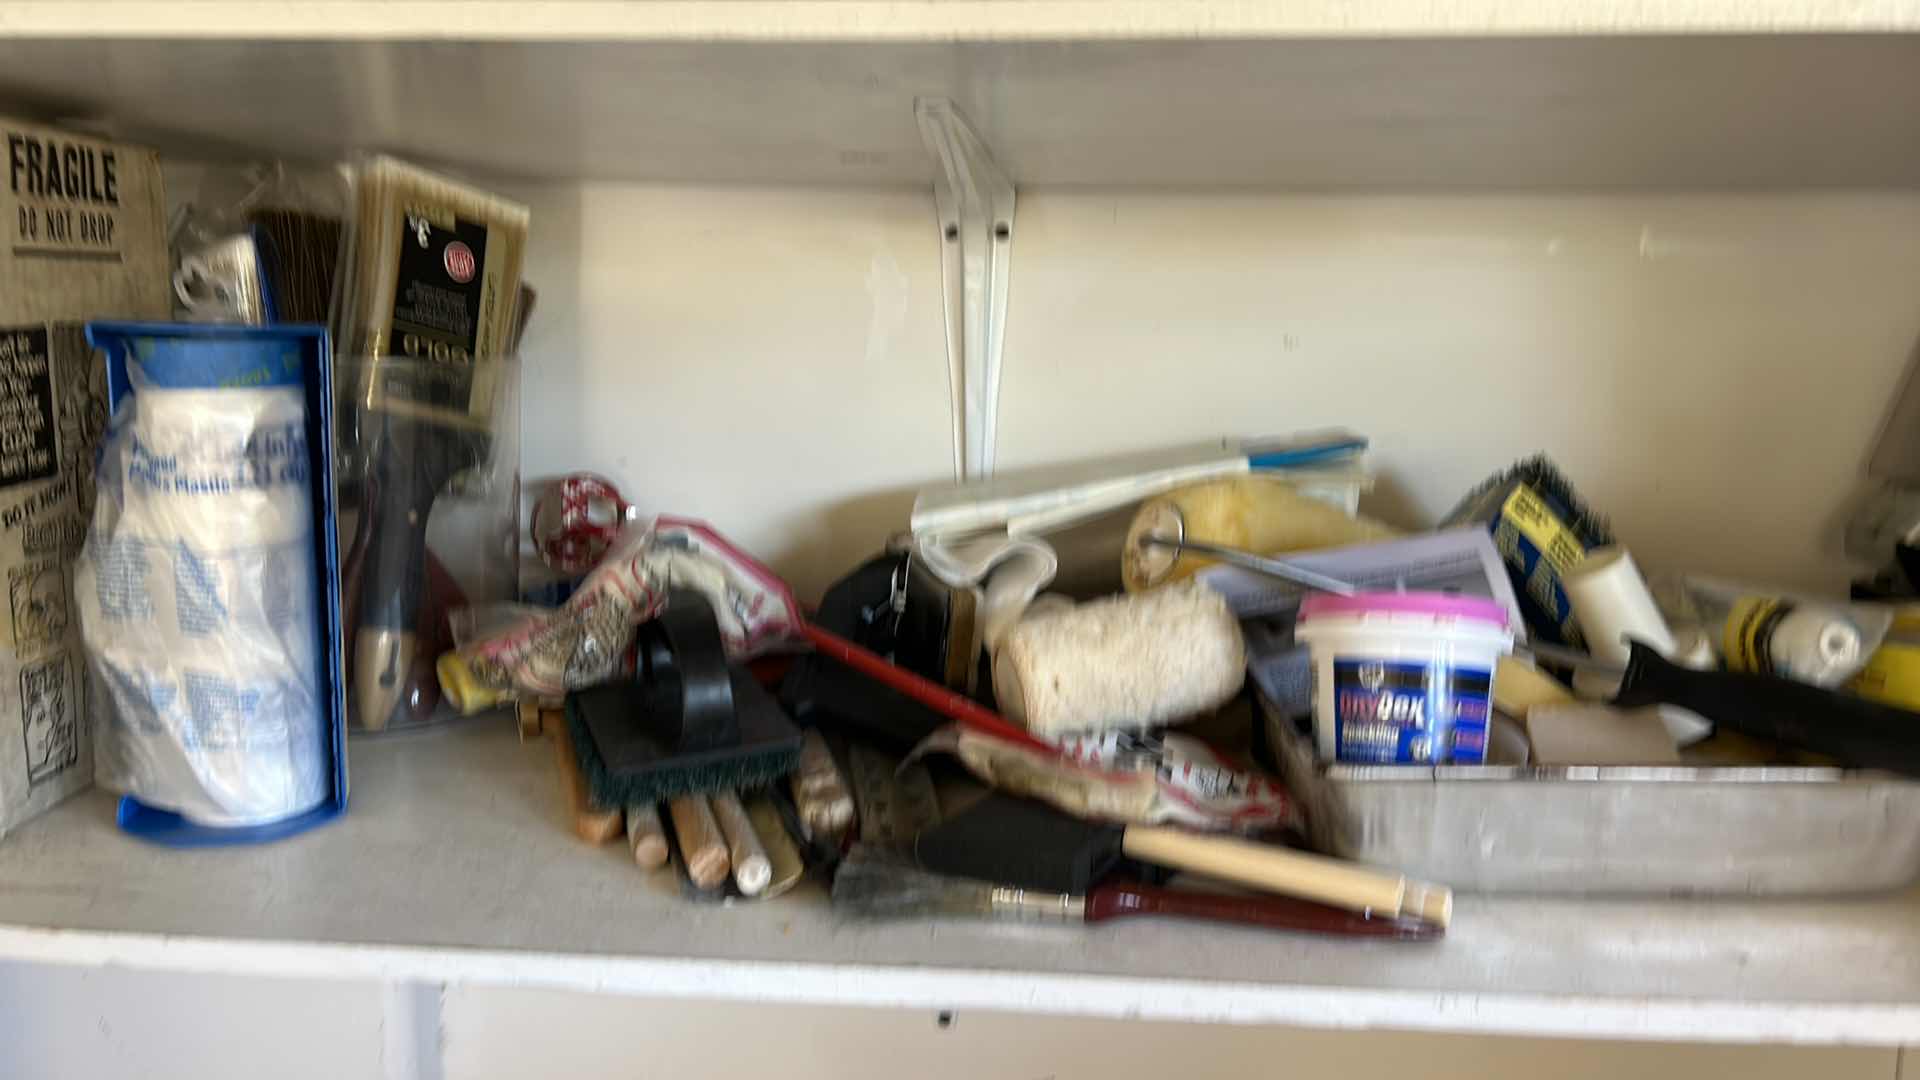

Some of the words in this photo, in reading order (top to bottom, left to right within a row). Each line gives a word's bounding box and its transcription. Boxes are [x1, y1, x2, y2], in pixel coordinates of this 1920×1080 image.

[8, 131, 120, 206] FRAGILE
[18, 204, 37, 241] DO
[46, 206, 72, 244] NOT
[80, 209, 114, 248] DROP
